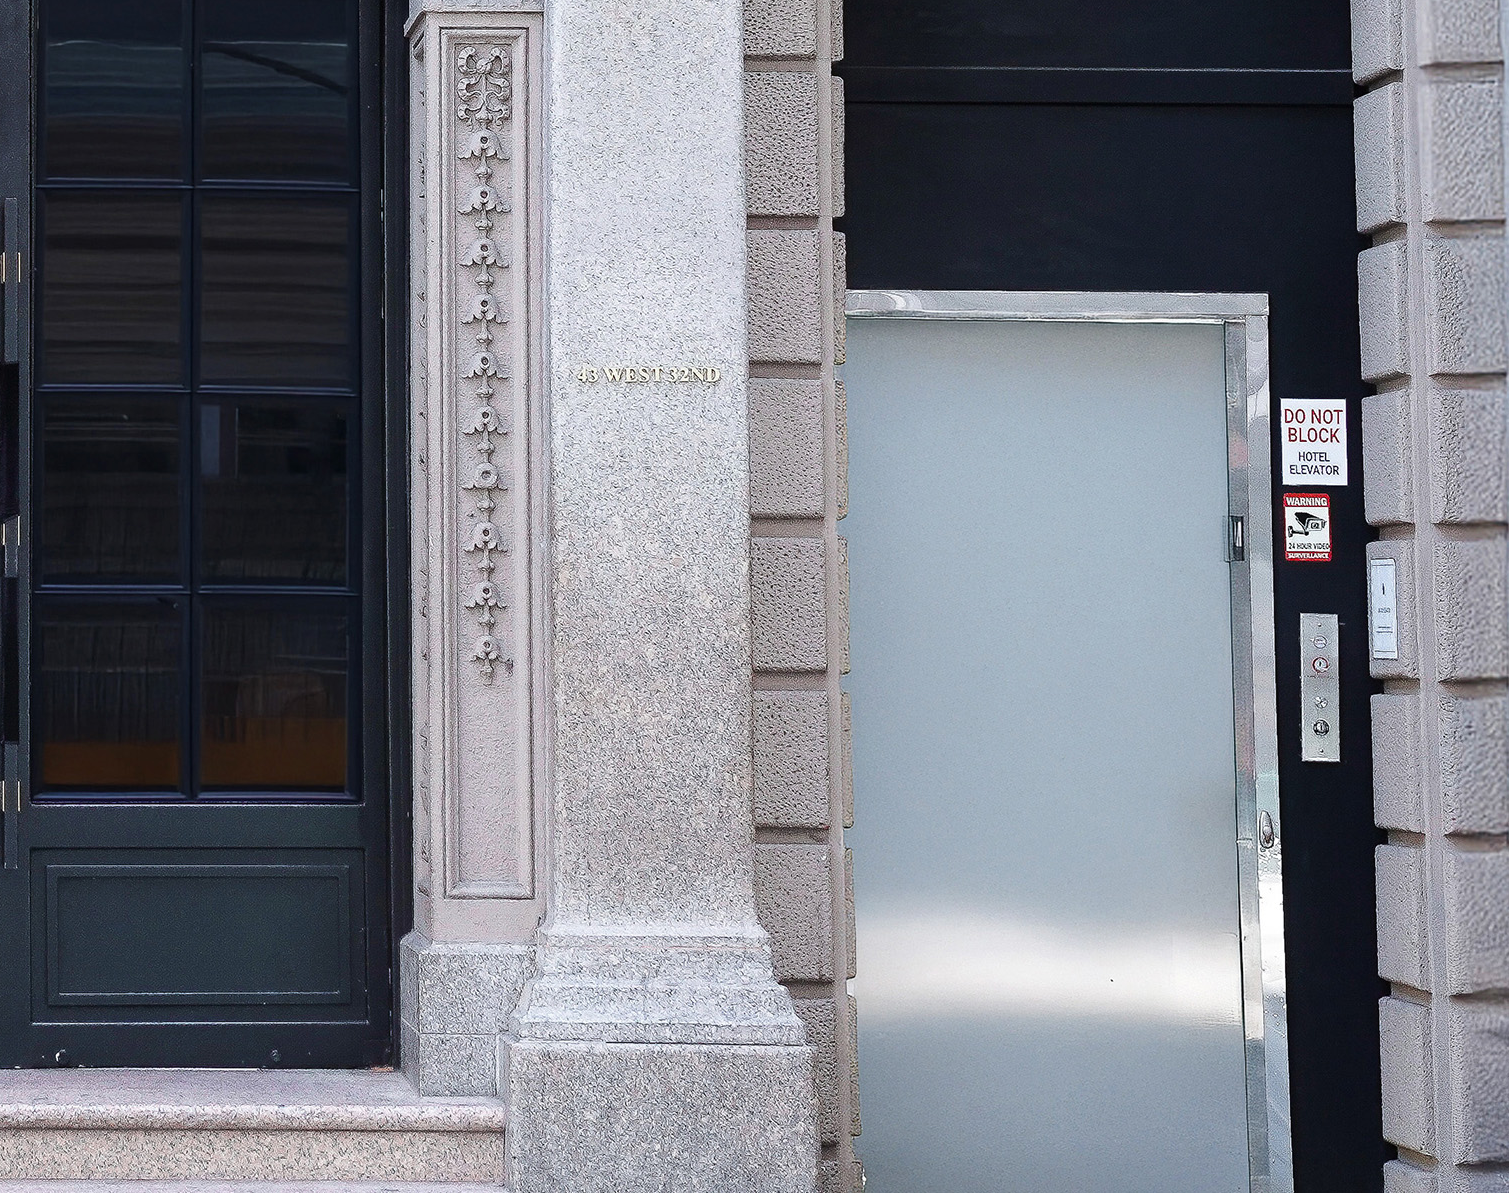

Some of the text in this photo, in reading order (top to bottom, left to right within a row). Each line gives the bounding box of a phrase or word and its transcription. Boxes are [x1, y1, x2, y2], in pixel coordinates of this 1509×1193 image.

[577, 367, 722, 384] 43 WEST 32ND
[1284, 408, 1344, 425] DO NOT
[1288, 427, 1340, 443] BLOCK
[1298, 451, 1331, 462] HOTEL
[1289, 465, 1340, 476] ELEVATOR
[1285, 496, 1328, 506] WARNING
